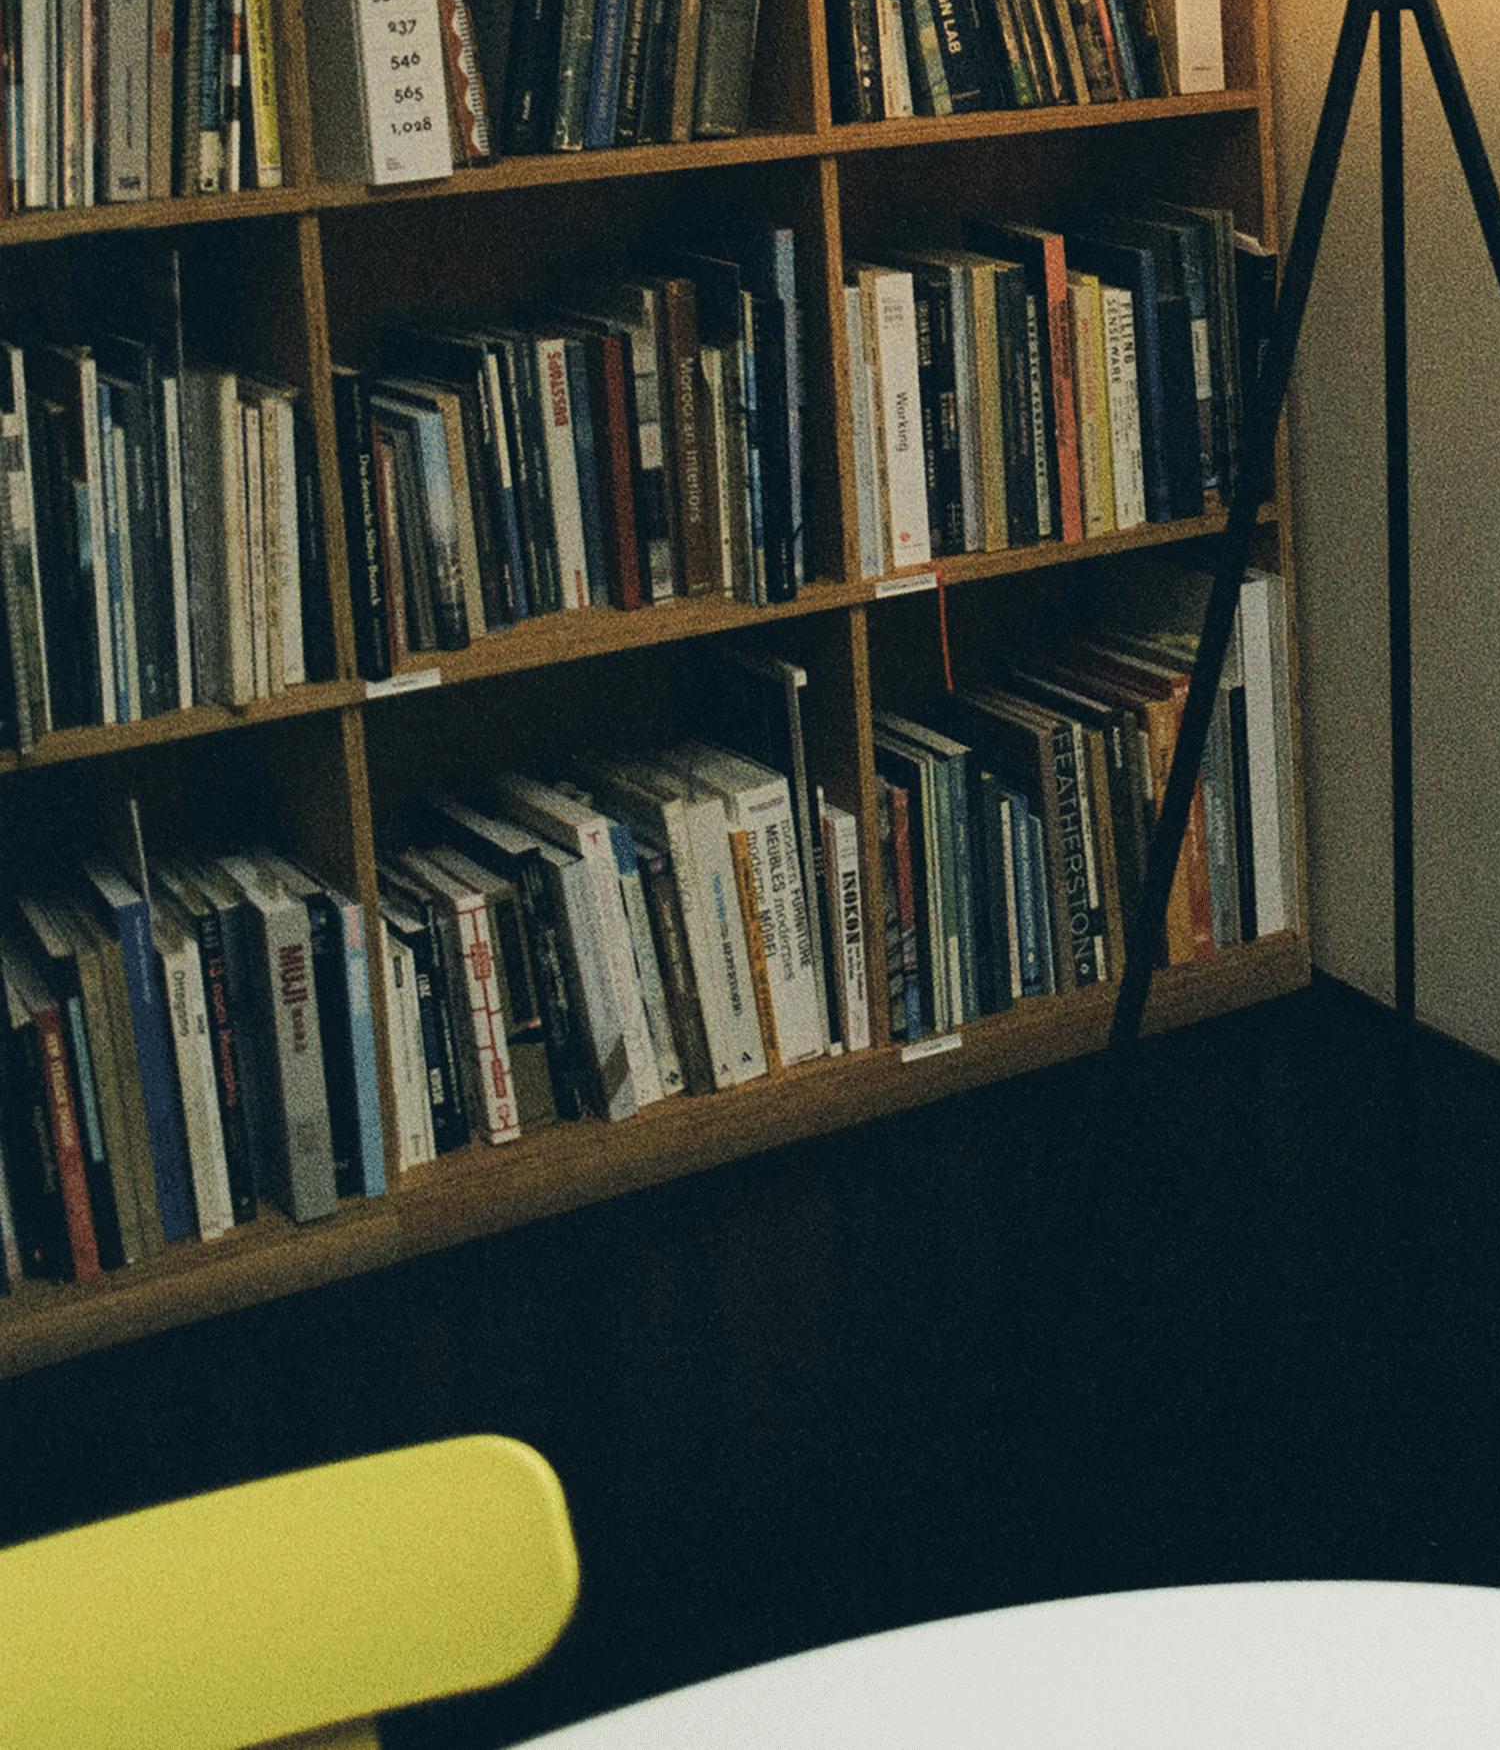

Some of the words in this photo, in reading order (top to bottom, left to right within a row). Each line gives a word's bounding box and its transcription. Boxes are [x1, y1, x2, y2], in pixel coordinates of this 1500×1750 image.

[388, 19, 417, 34] 237
[942, 20, 962, 54] LAB
[391, 52, 420, 70] 546
[394, 87, 423, 102] 565
[391, 118, 432, 136] 1,028
[1106, 299, 1121, 385] SENSEWARE
[895, 392, 909, 452] Working
[685, 450, 703, 524] Interiors
[747, 831, 767, 906] moderne
[764, 824, 785, 892] MEUBLES
[1051, 731, 1092, 961] FEATHERSTON
[780, 818, 798, 884] modern
[790, 889, 811, 969] FURNITURE
[842, 870, 861, 945] ISOKON
[774, 897, 795, 981] modernes
[277, 943, 308, 1005] MUJI
